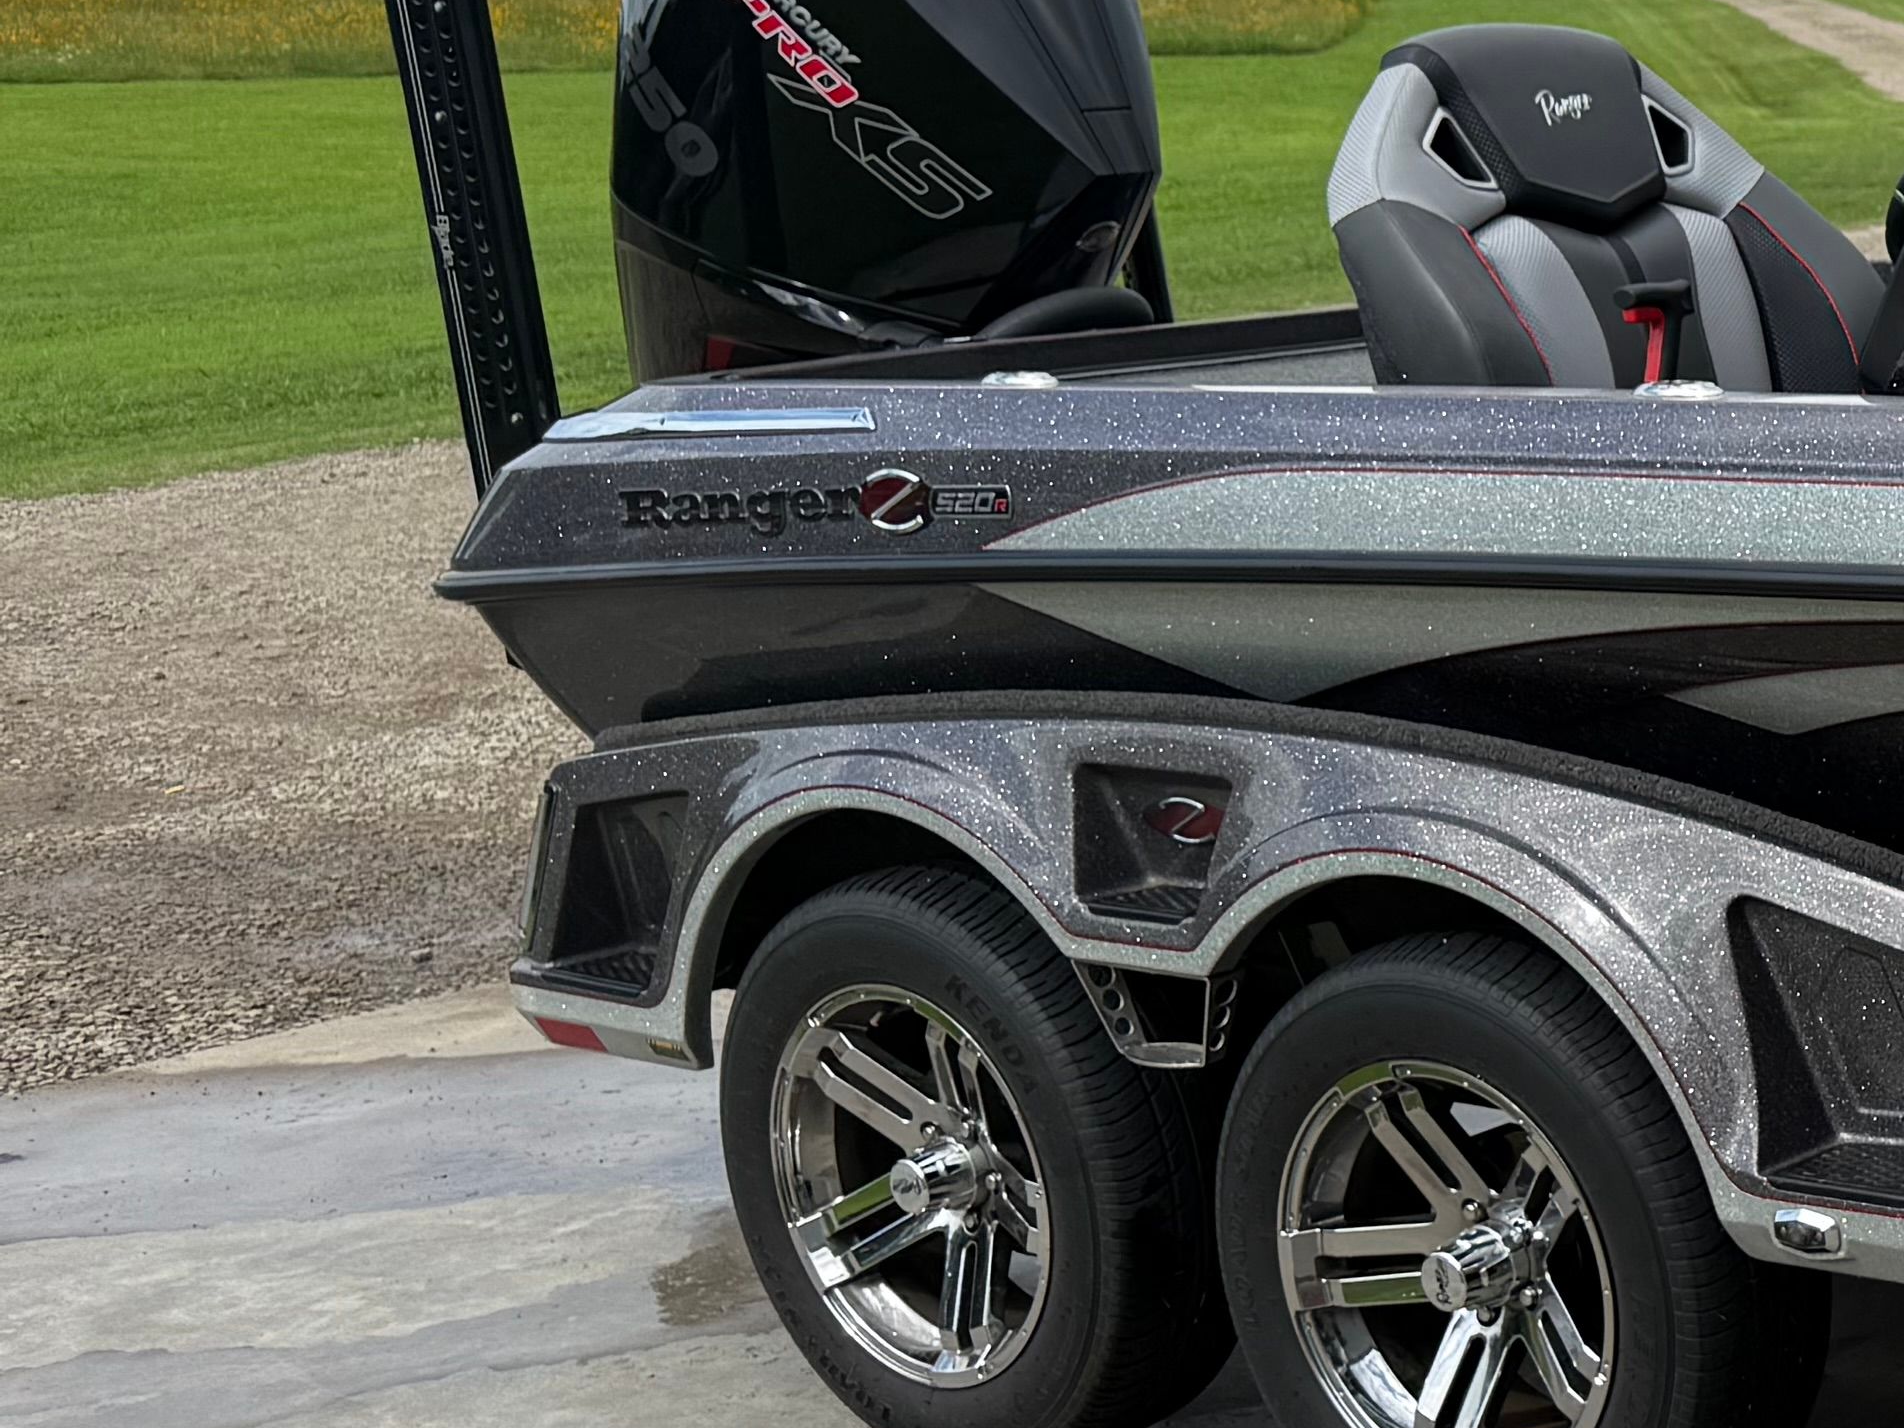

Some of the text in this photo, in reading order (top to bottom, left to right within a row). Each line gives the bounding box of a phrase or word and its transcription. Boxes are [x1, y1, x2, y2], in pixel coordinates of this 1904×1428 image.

[767, 72, 992, 220] XS
[1534, 88, 1593, 128] Ranger
[619, 484, 861, 536] Ranger
[944, 974, 1040, 1095] KENDA
